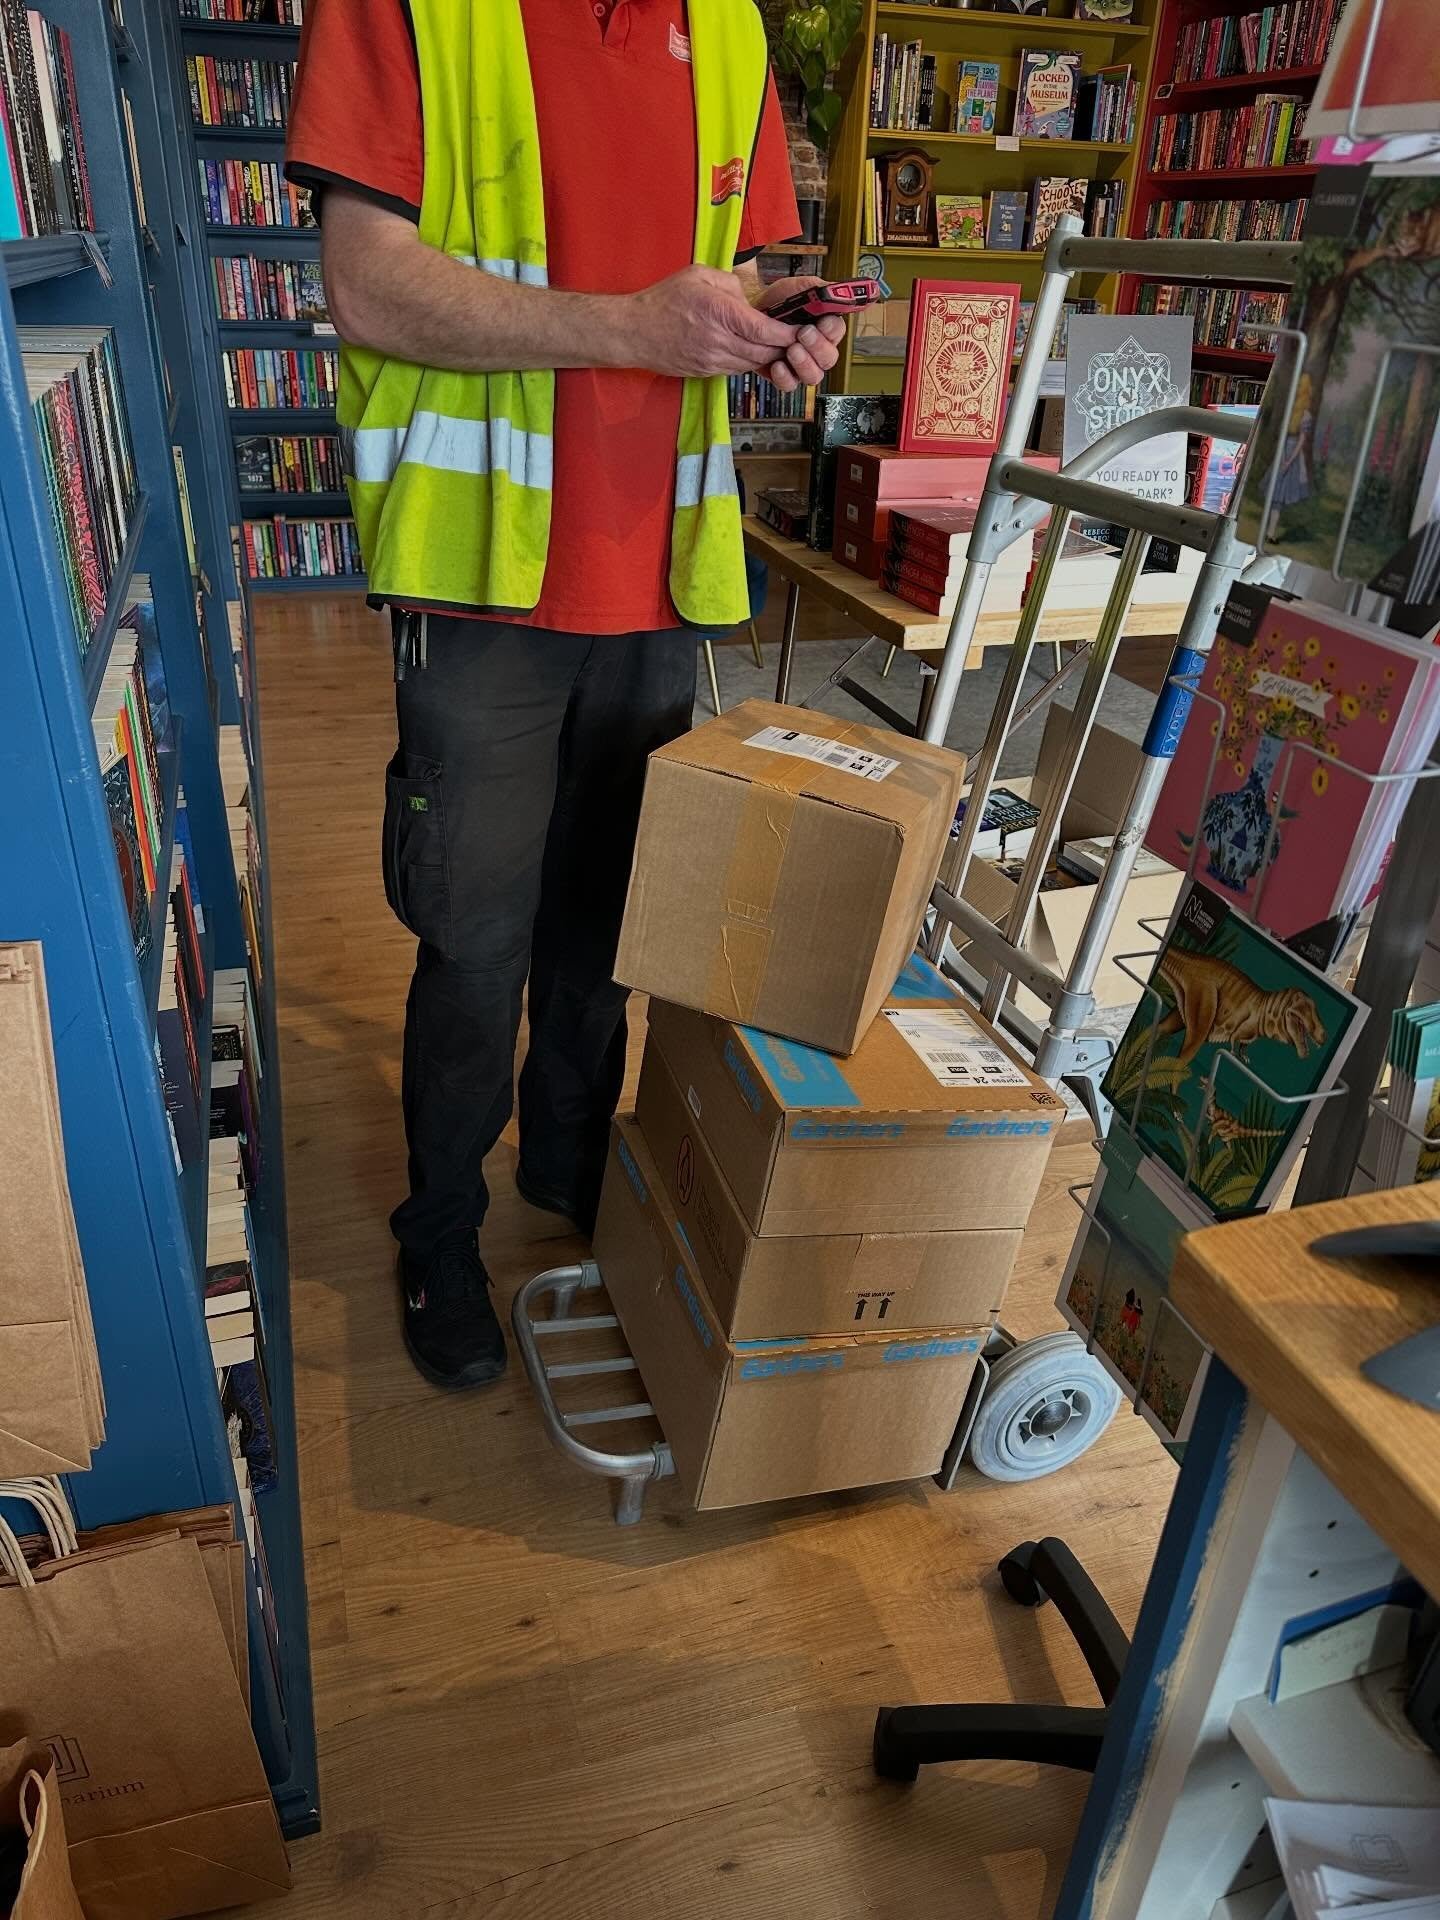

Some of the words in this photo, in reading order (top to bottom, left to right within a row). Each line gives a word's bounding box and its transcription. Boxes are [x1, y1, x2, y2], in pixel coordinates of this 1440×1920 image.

[1033, 73, 1070, 84] LOCKED
[1030, 89, 1068, 99] MUSEUM
[1043, 182, 1080, 201] CHOOSE
[1046, 199, 1068, 212] YOUR
[886, 234, 929, 242] IMAGINARIUM
[1093, 366, 1165, 393] ONYX
[1097, 470, 1119, 482] YOU
[1122, 470, 1160, 482] READY
[1164, 470, 1178, 482] TO
[1137, 487, 1173, 500] DARK?
[1083, 528, 1111, 536] REBECC
[790, 1117, 906, 1140] Gardners
[945, 1116, 1053, 1138] Gardners
[881, 1336, 981, 1364] Gardners
